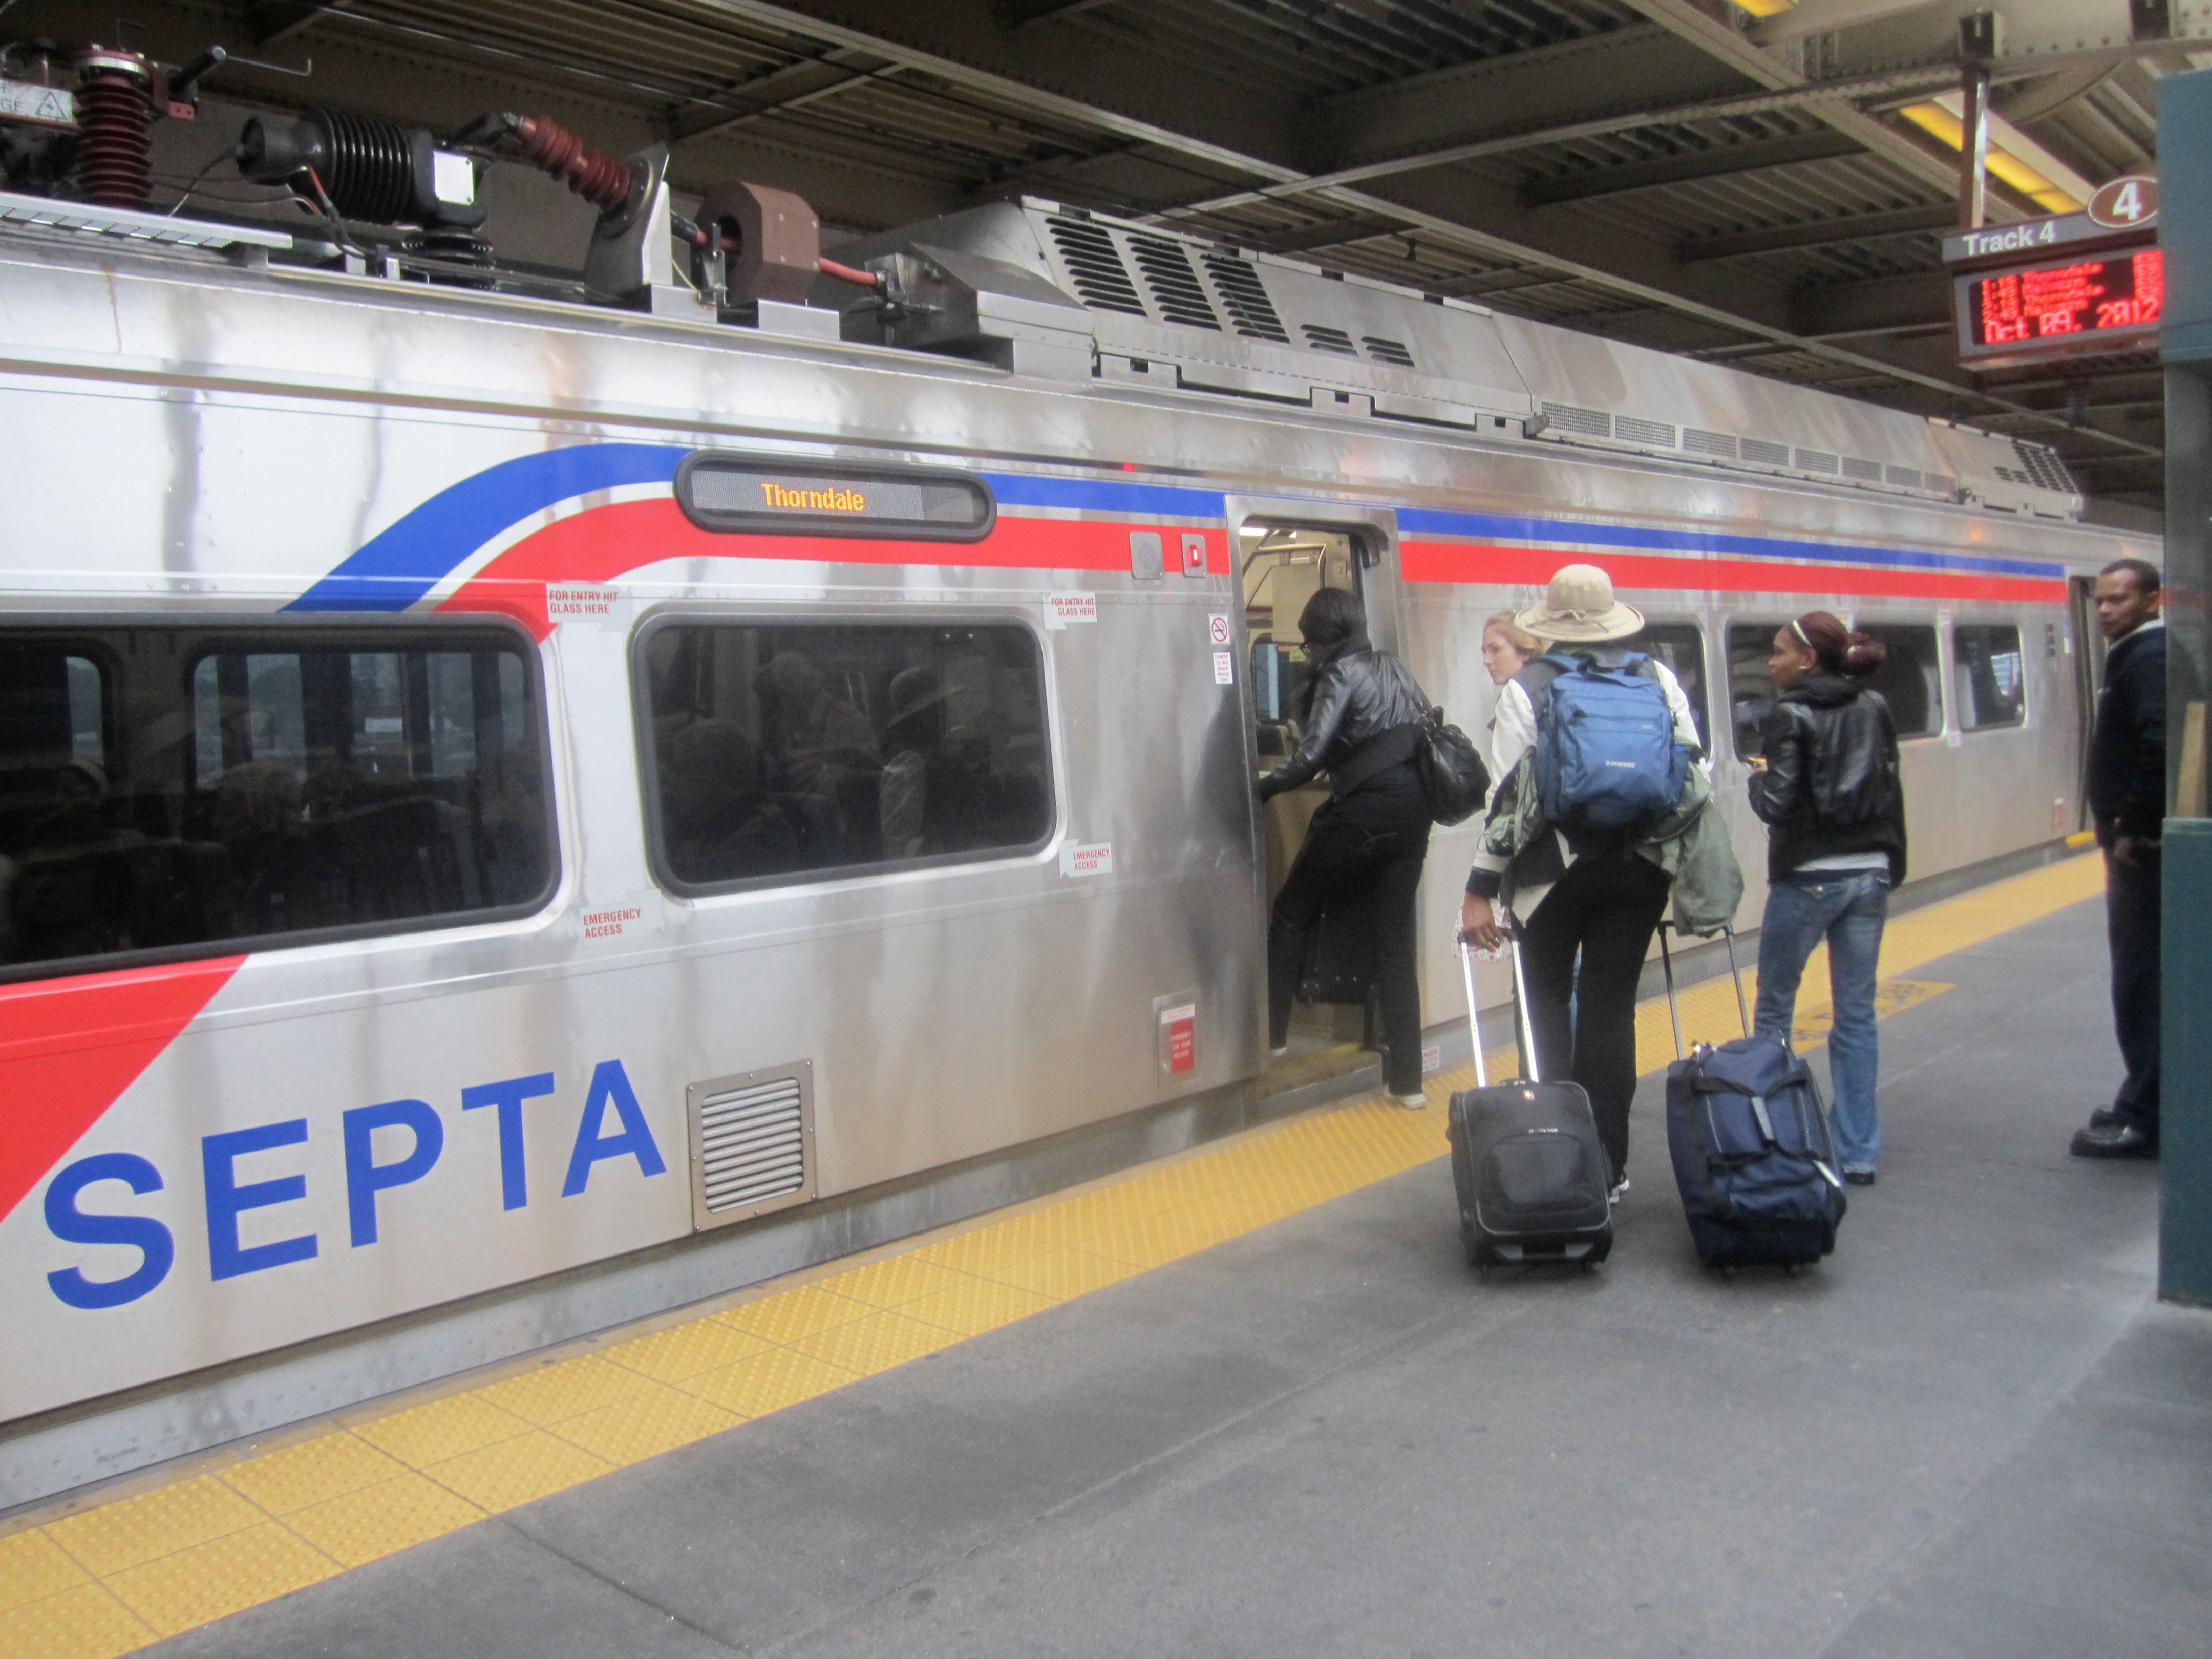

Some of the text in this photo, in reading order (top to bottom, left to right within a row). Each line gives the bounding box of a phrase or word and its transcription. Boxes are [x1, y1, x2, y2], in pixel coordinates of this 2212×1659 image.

[2113, 182, 2141, 220] 4
[1963, 221, 2057, 256] Track 4
[1984, 316, 2030, 344] Oct
[2096, 297, 2159, 328] 2012
[761, 483, 865, 511] Thorndale
[549, 590, 618, 602] FOR ENTRY HIT
[1051, 598, 1094, 606] FOR ENTRY HIT
[550, 603, 609, 614] GLASS HERE
[1058, 607, 1095, 616] GLASS HERE
[1073, 848, 1110, 861] EMERGENCY
[1074, 860, 1098, 871] ACCESS
[583, 908, 641, 926] EMERGENCY
[585, 923, 622, 939] ACCESS
[44, 1059, 667, 1310] SEPTA
